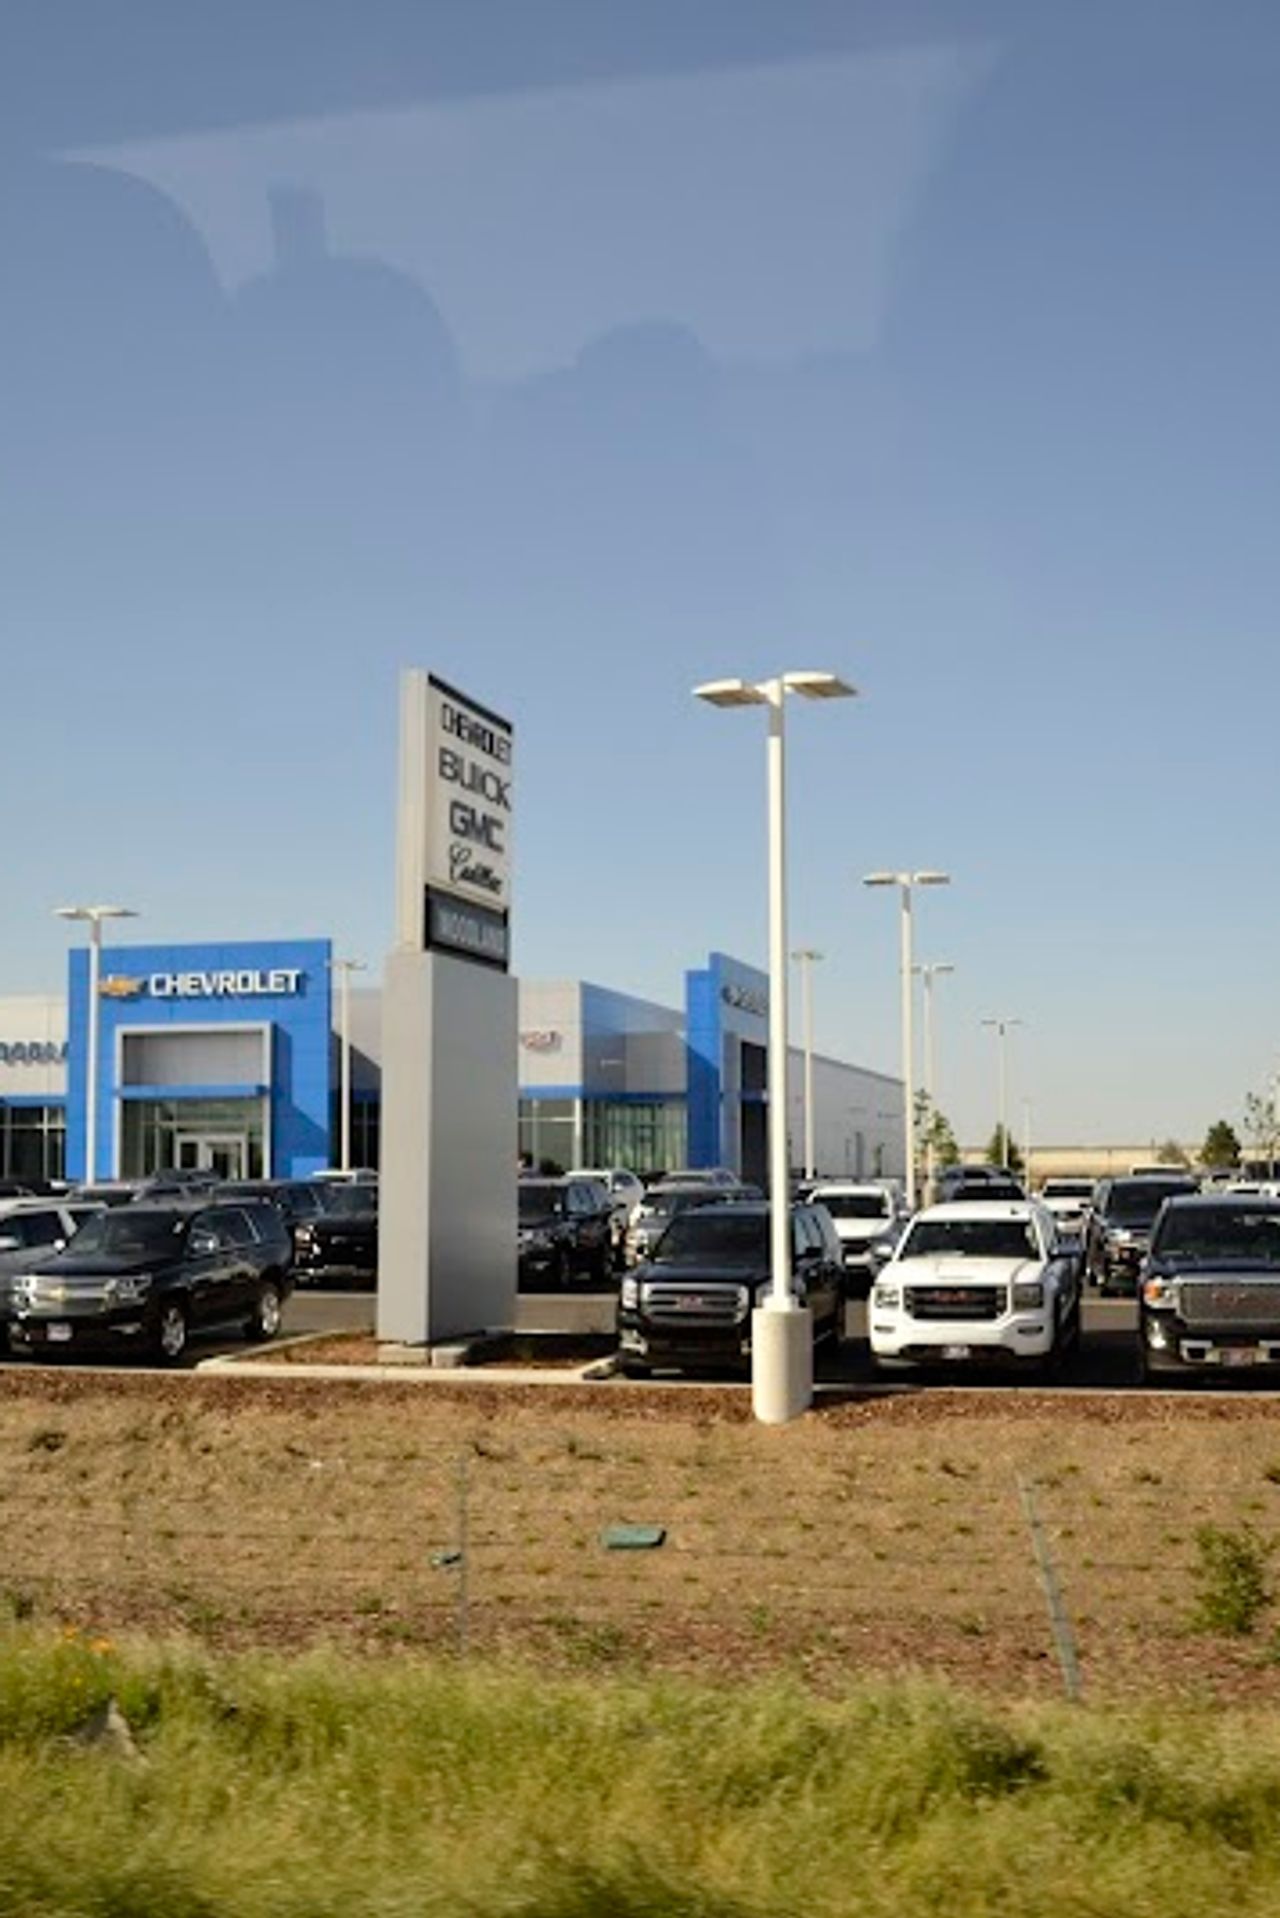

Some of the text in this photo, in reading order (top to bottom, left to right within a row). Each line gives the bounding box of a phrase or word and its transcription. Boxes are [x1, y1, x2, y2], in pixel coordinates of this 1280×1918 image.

[438, 747, 512, 811] BUICK
[449, 801, 504, 854] GMC
[150, 969, 301, 996] CHEVROLET
